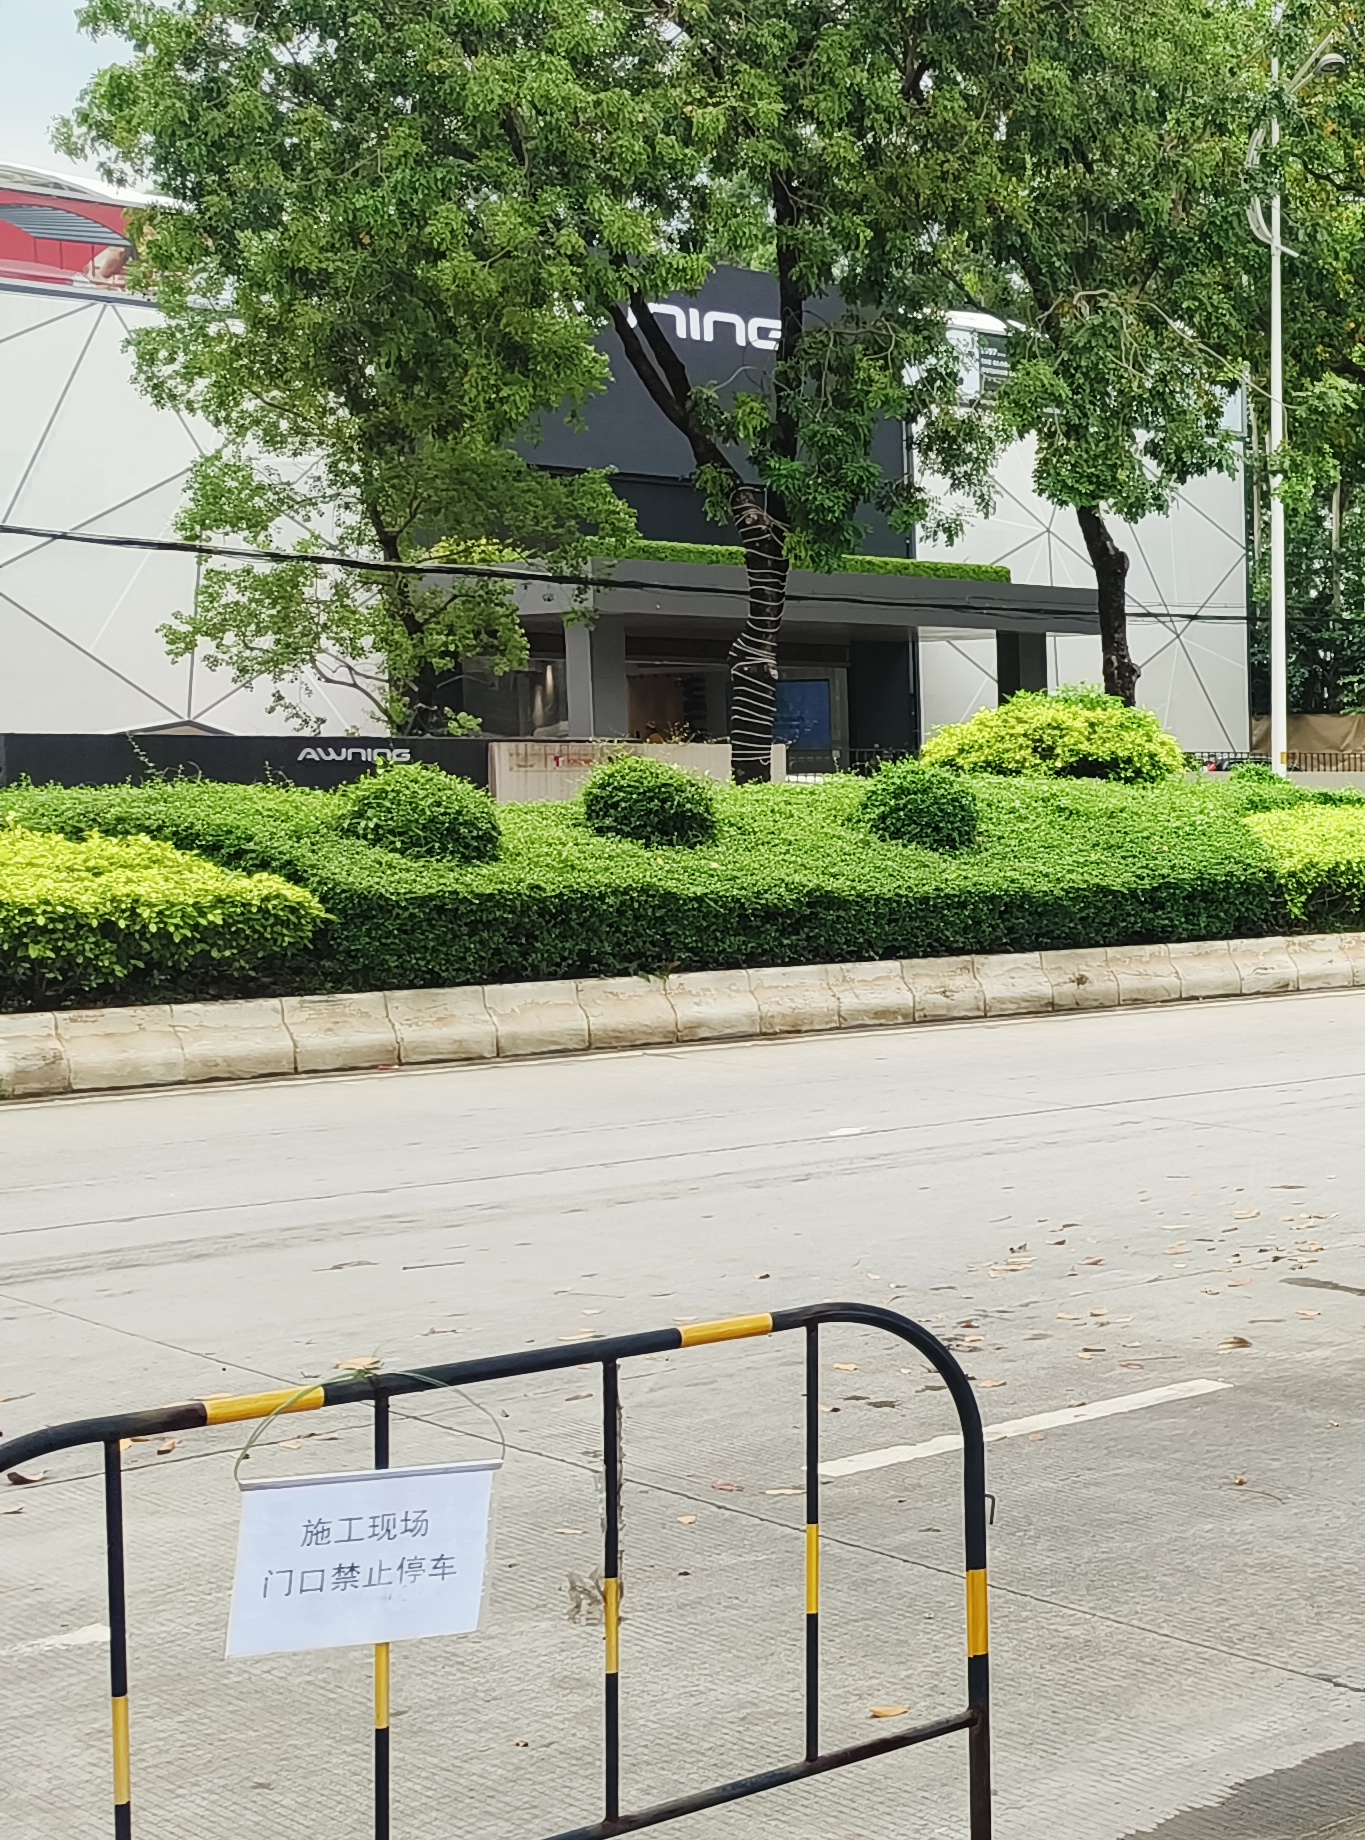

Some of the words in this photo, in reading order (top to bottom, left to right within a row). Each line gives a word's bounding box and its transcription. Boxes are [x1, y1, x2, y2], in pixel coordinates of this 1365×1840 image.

[300, 1509, 429, 1548] 施工现场
[262, 1553, 457, 1599] 门口禁止停车
